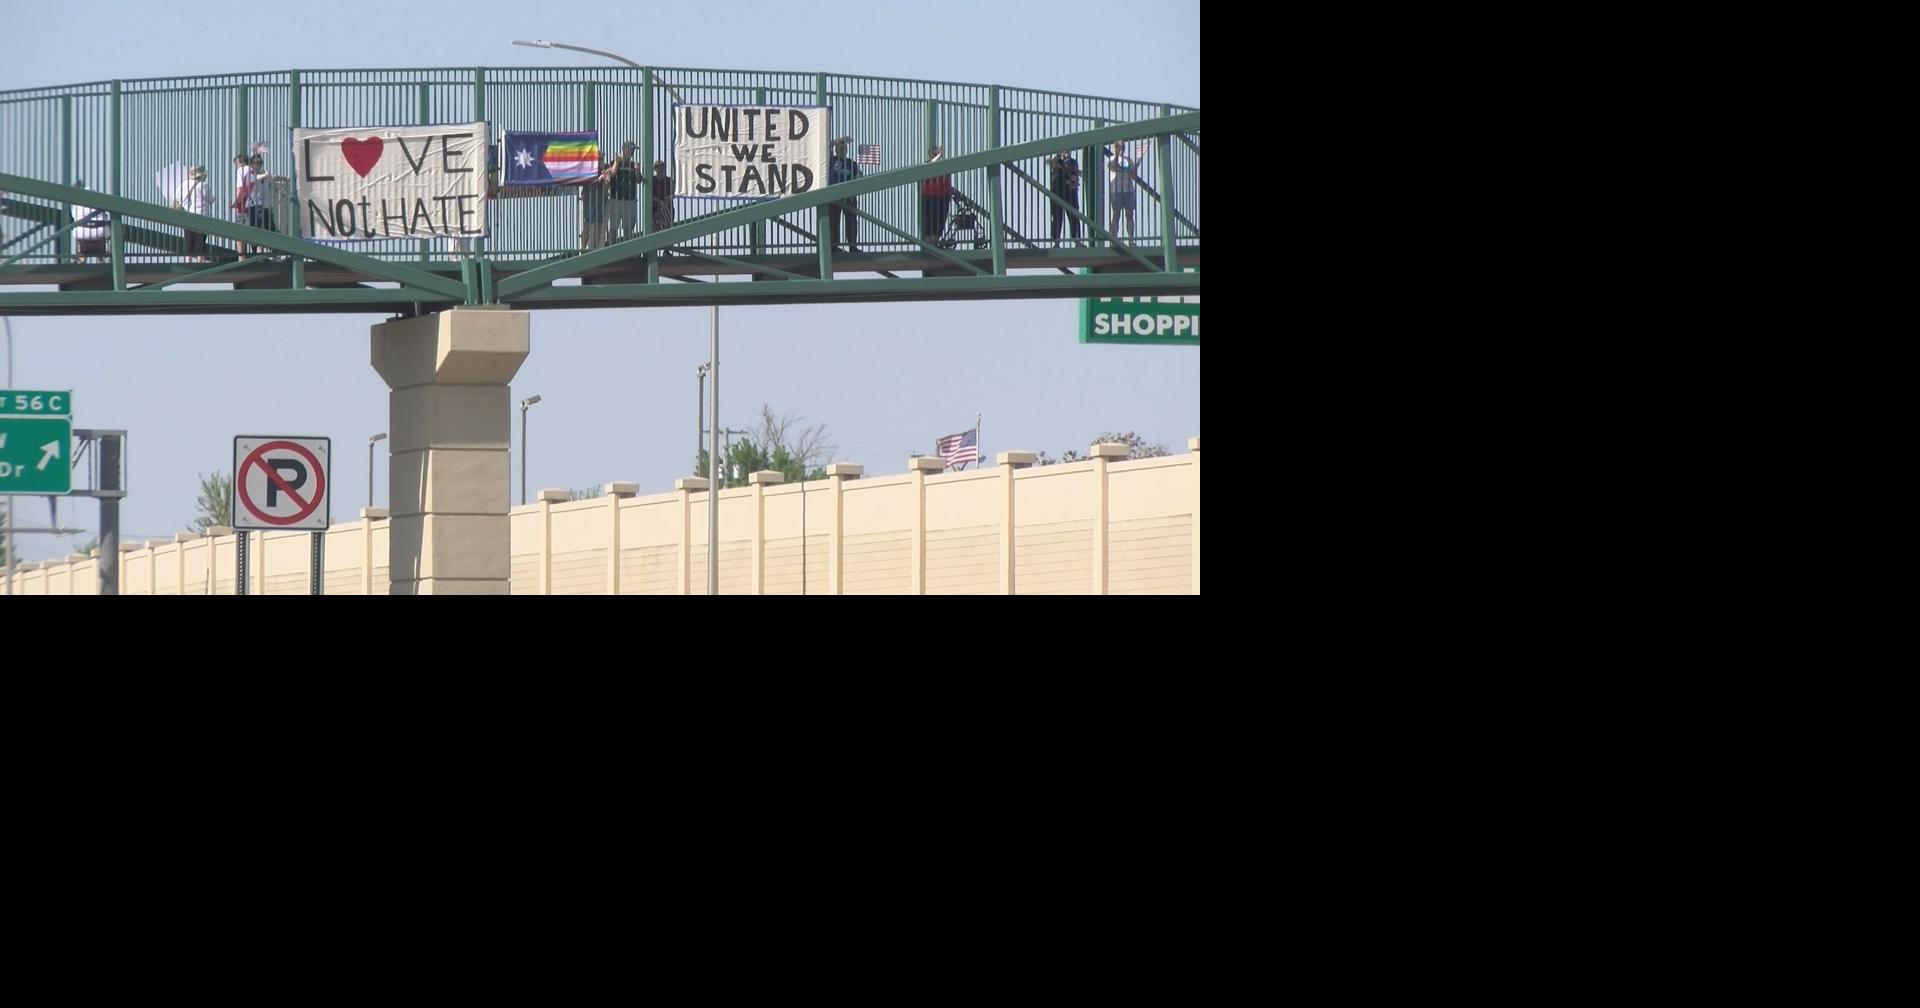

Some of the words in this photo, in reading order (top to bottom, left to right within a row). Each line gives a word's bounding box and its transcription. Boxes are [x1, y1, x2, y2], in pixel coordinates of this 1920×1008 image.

[685, 106, 810, 142] UNITED
[304, 133, 474, 182] LVE
[731, 143, 777, 163] WE
[695, 163, 814, 195] STAND
[381, 194, 482, 236] HATE
[1094, 313, 1199, 336] SHOPPI
[15, 395, 43, 411] 56
[49, 396, 62, 411] C
[0, 461, 25, 478] Dr
